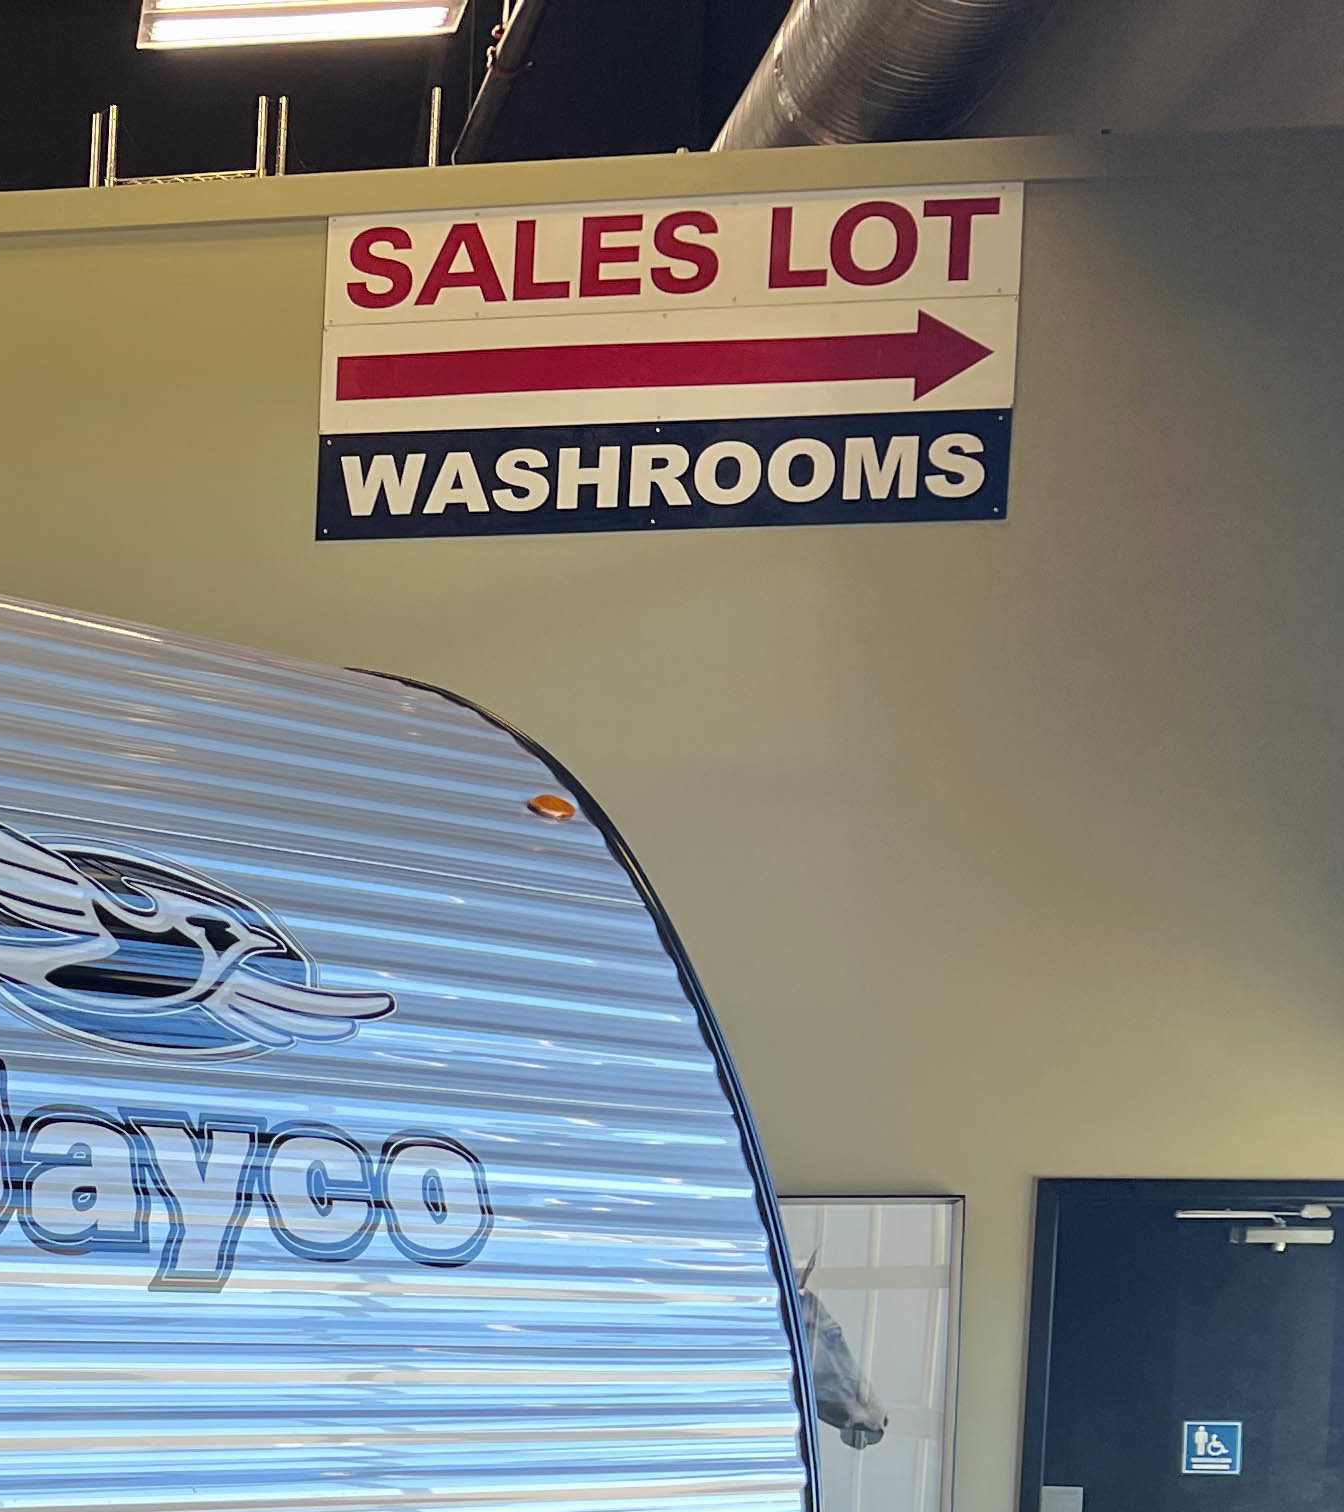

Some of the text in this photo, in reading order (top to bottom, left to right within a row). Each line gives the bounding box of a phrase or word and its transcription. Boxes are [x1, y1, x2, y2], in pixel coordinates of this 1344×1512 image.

[347, 197, 1000, 310] SALES LOT
[341, 433, 986, 518] WASHROOMS
